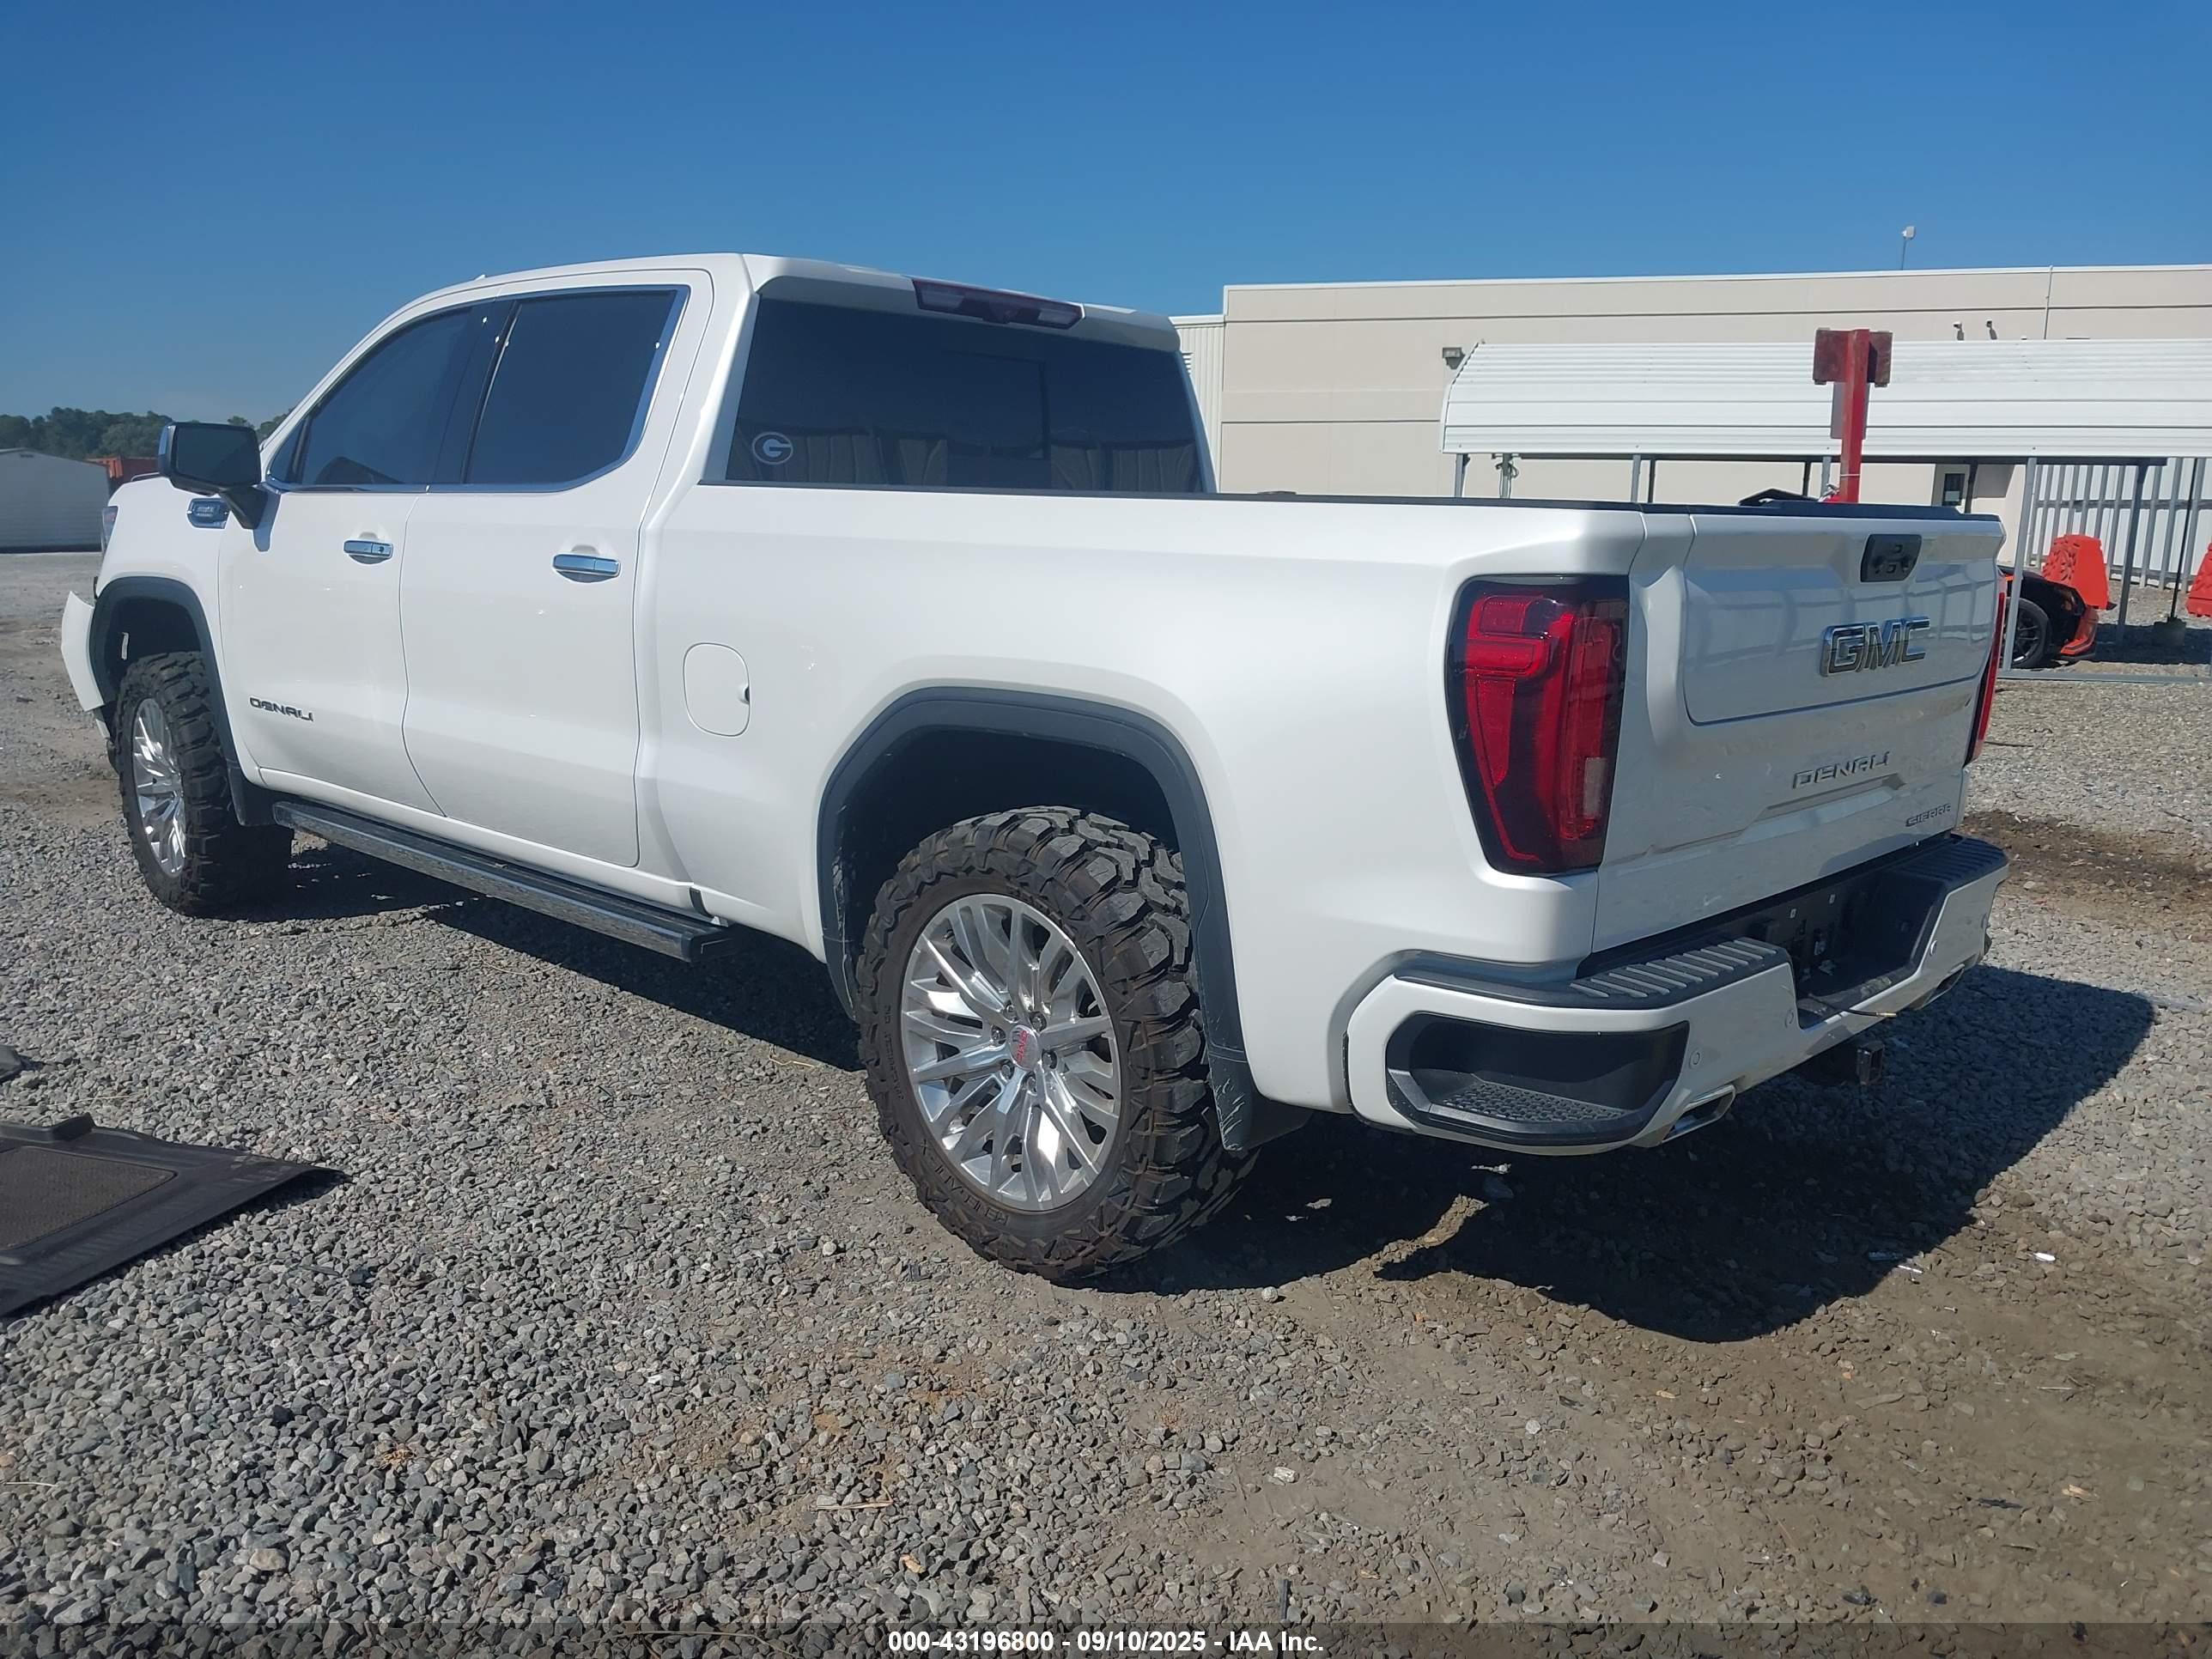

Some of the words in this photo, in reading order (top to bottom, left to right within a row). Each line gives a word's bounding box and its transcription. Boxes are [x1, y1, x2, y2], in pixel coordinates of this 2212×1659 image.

[1820, 615, 1931, 678] GMC
[249, 696, 314, 722] DENALI
[1791, 751, 1891, 790] DENALI
[1905, 804, 1952, 828] SIERRA
[1016, 1029, 1028, 1063] GMC
